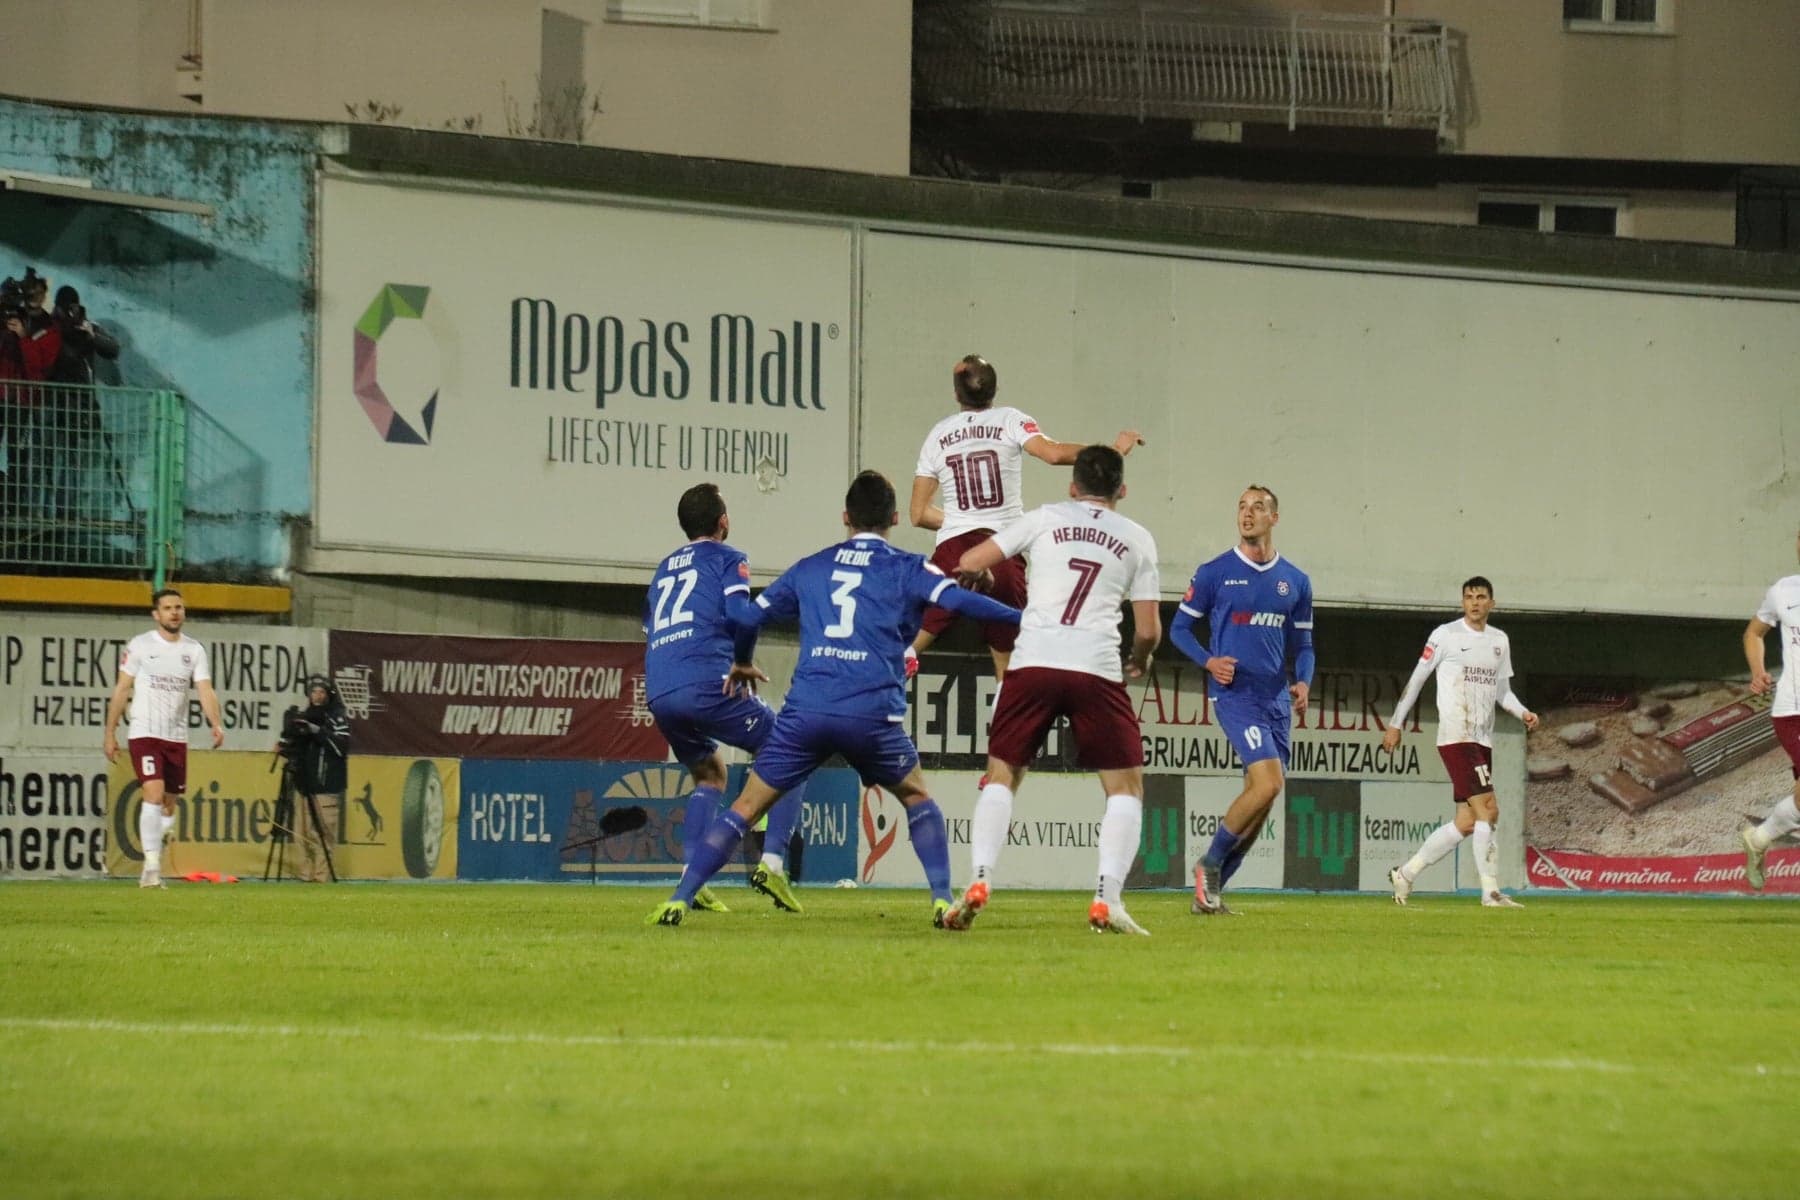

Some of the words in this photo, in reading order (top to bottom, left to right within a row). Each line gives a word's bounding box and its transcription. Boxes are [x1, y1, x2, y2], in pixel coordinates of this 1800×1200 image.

[509, 297, 691, 410] Mepas
[547, 415, 668, 469] LIFESTYLE
[678, 424, 693, 471] U
[701, 426, 788, 477] TRENDU
[945, 449, 1004, 512] 10
[653, 569, 698, 634] 22
[823, 569, 863, 638] 3
[1060, 557, 1103, 626] 7
[42, 637, 310, 695] ELEKTIVREDA
[381, 660, 623, 699] WWW.JUVENTASPORT.COM
[34, 696, 64, 725] HZ
[440, 705, 500, 734] KUPUJ
[499, 706, 573, 736] ONLINE!
[1243, 725, 1262, 750] 19
[141, 755, 156, 777] 6
[470, 792, 552, 844] HOTEL
[1035, 820, 1102, 848] VITALIS
[1598, 867, 1688, 886] mračna...
